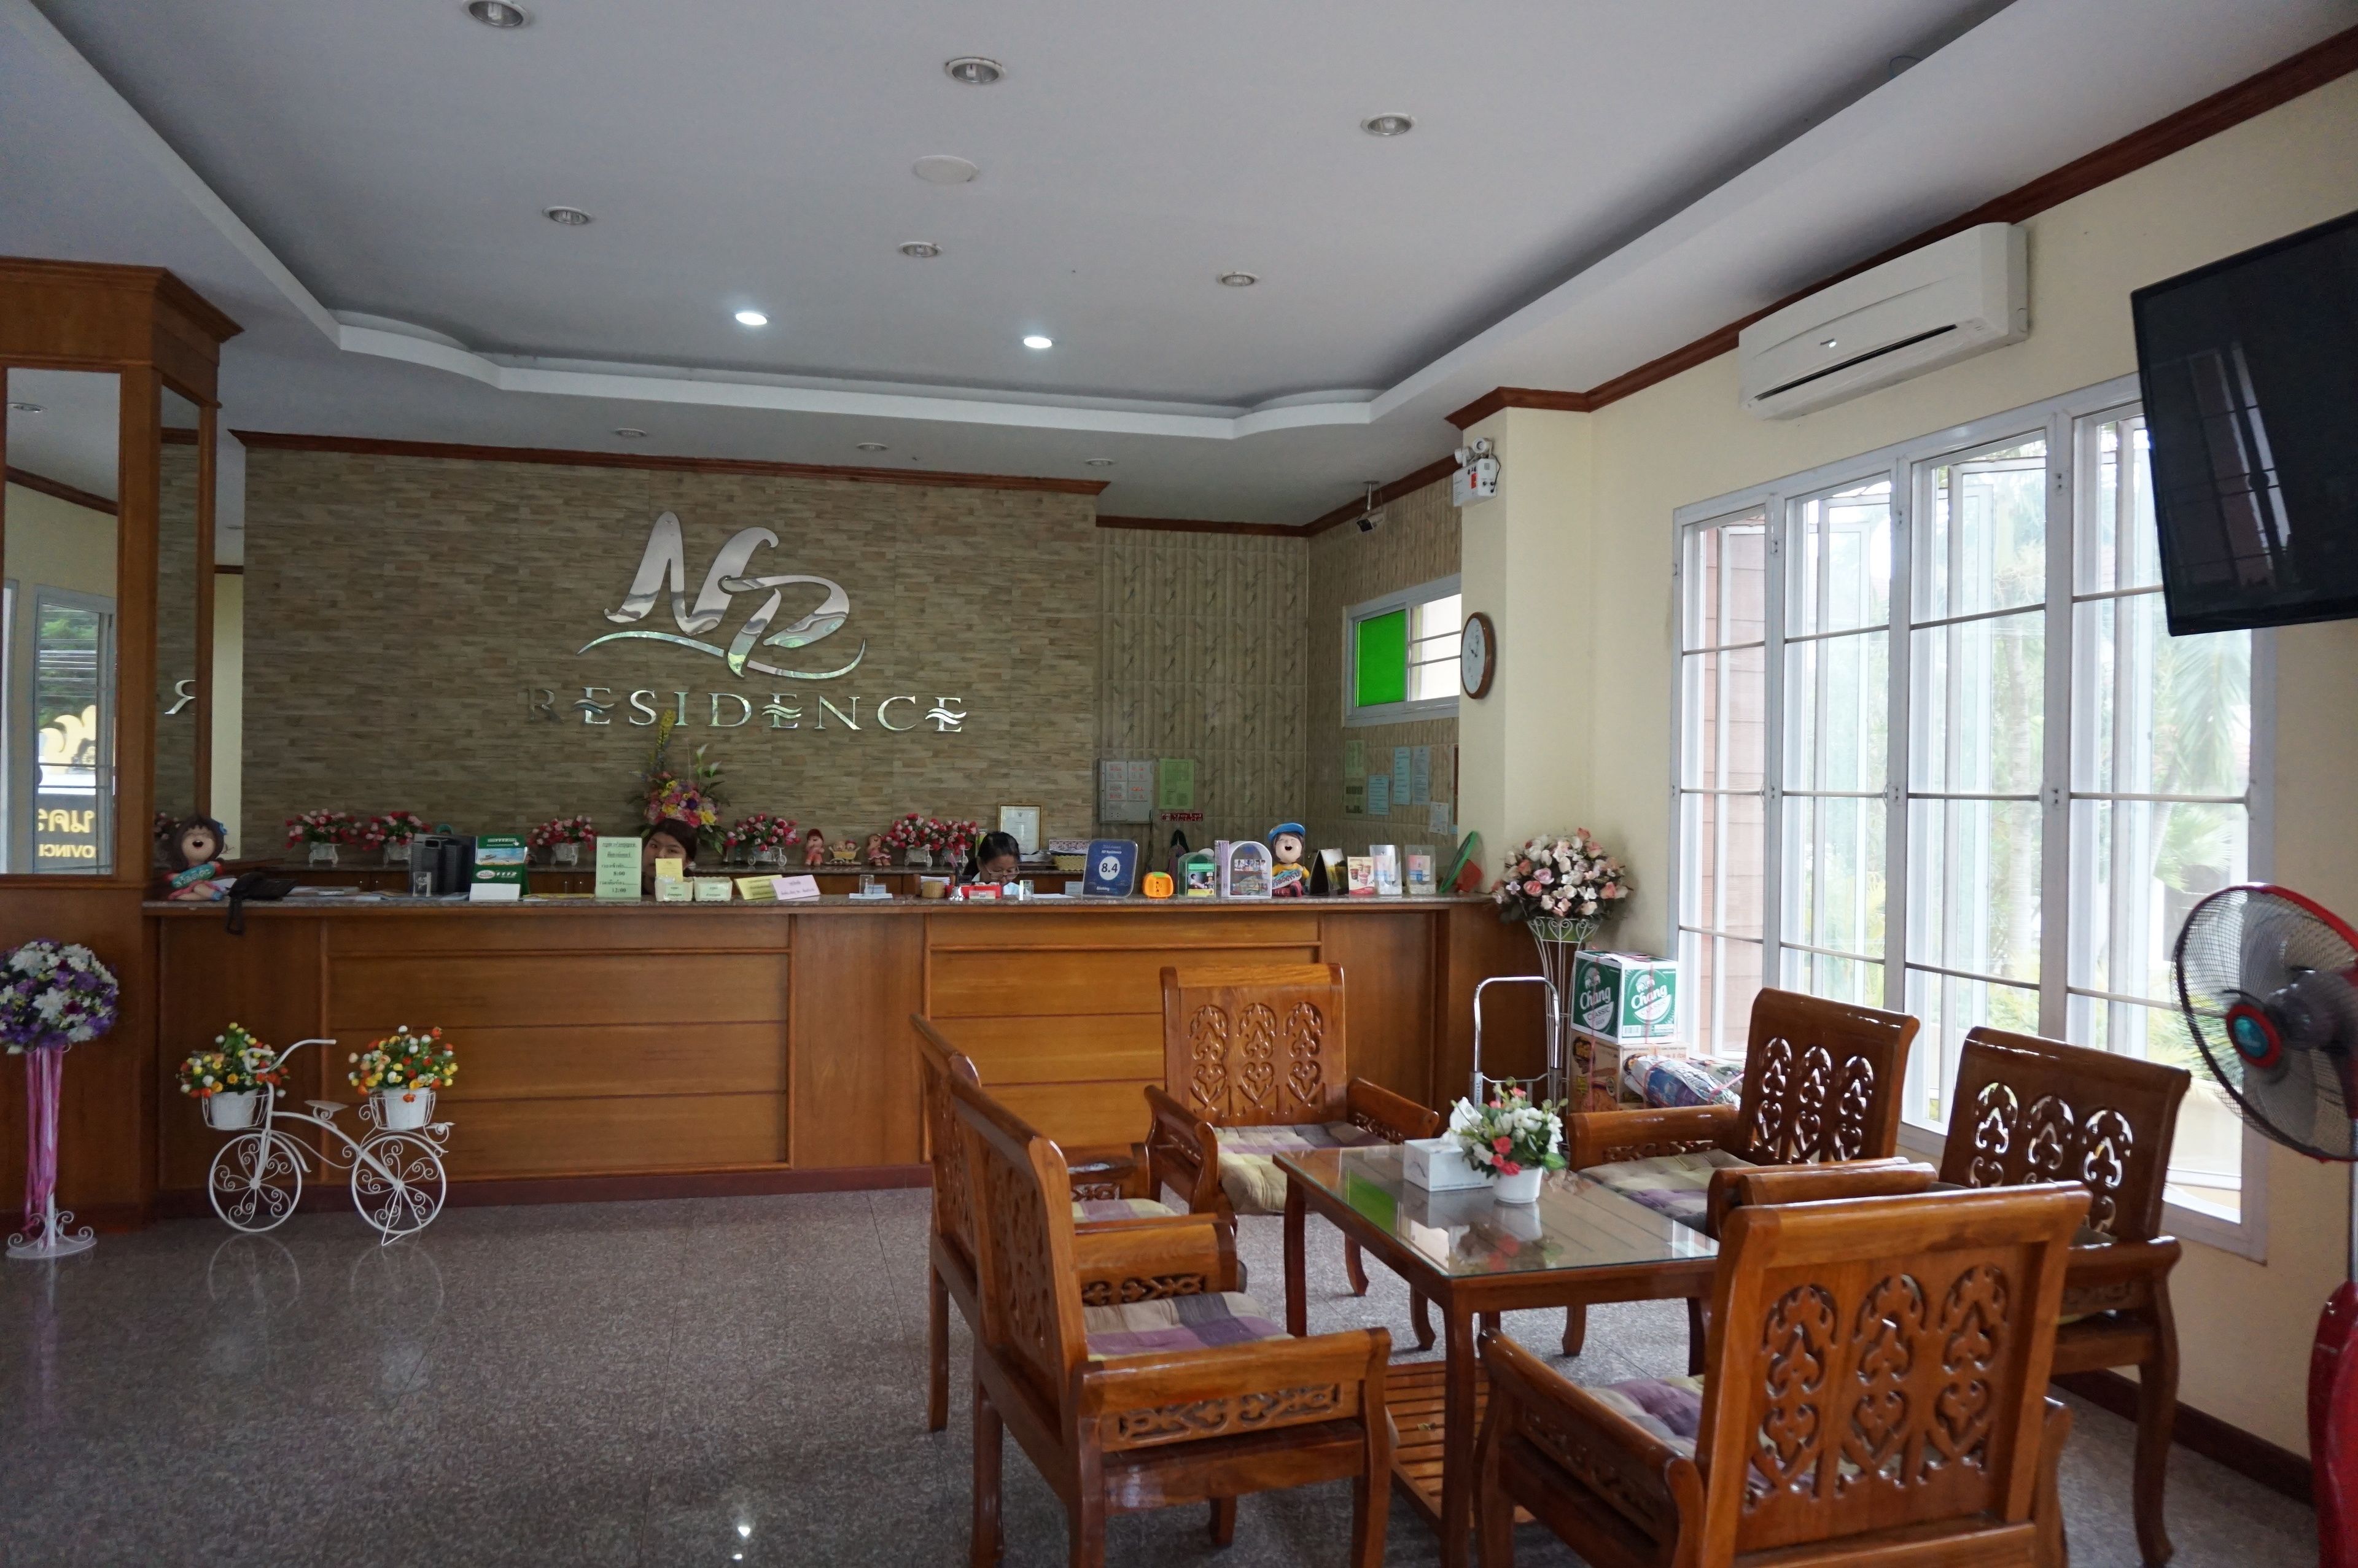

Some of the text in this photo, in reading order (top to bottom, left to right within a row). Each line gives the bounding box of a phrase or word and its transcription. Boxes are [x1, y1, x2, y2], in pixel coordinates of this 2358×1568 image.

[528, 686, 968, 732] RESIDENCE
[1101, 863, 1118, 873] 8.4
[1580, 987, 1611, 1011] Chang
[1631, 984, 1668, 1009] Chang
